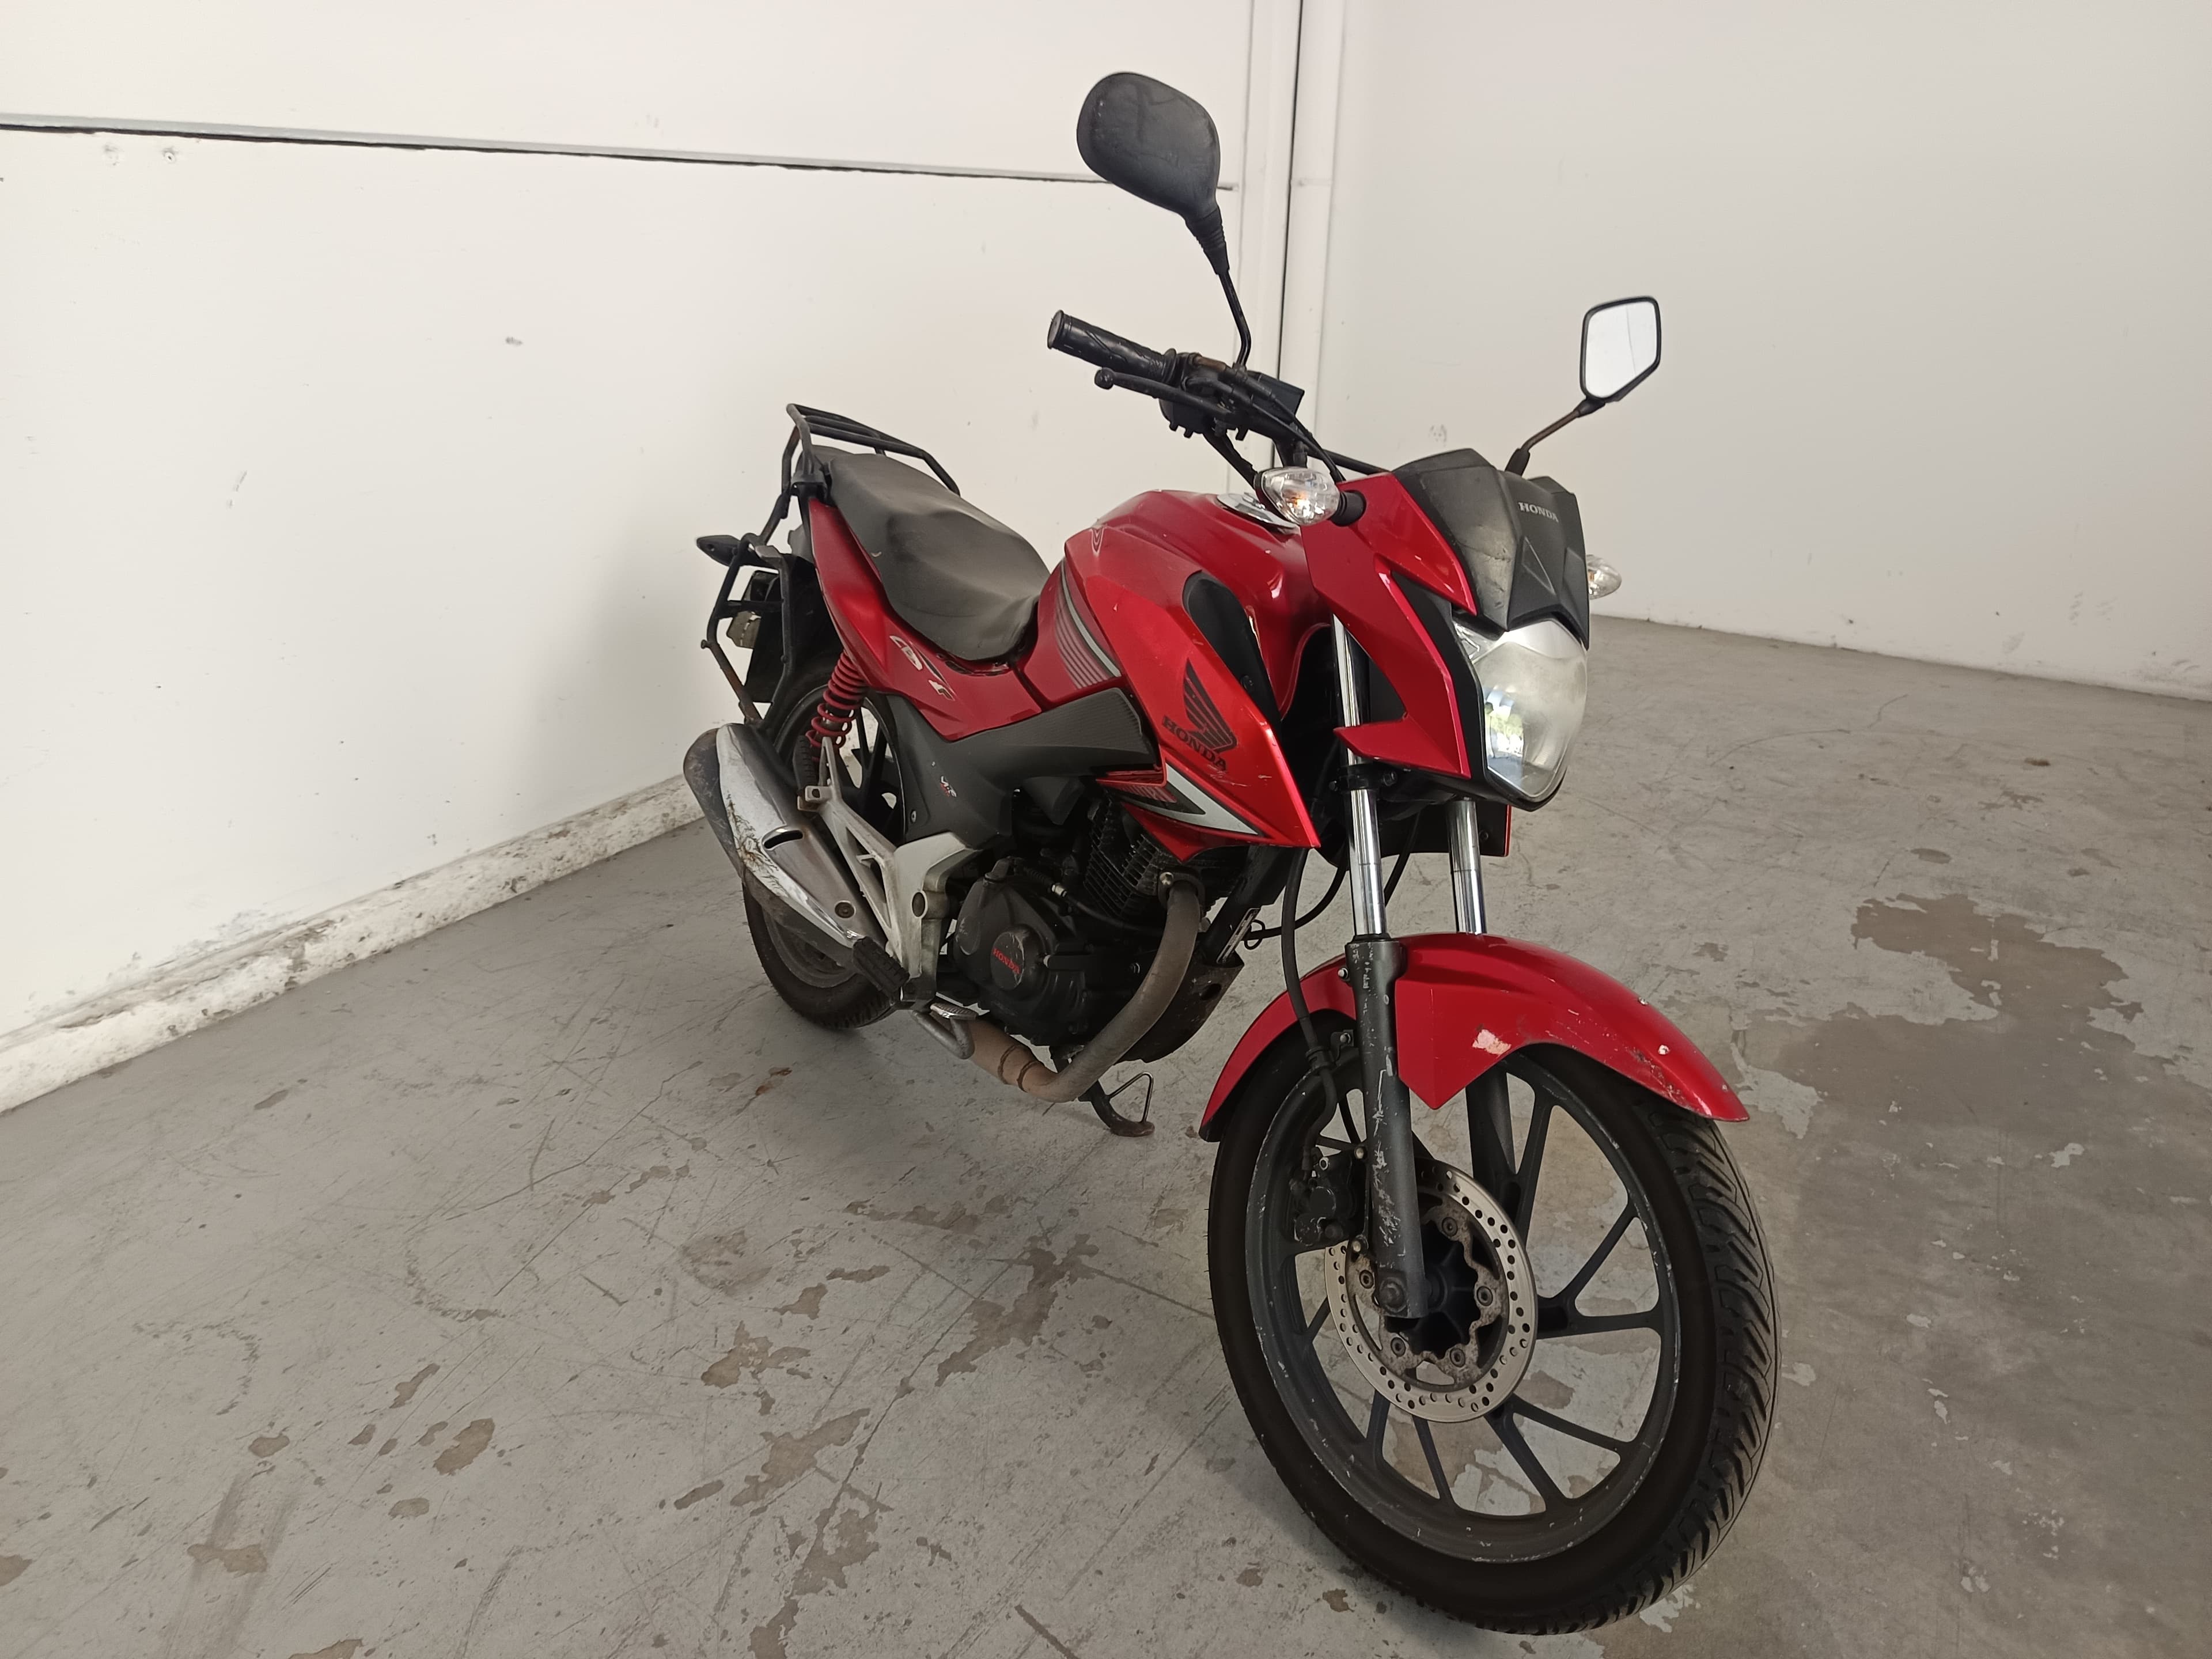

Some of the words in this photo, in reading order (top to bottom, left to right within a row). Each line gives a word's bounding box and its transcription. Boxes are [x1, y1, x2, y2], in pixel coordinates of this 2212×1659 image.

[1518, 502, 1559, 523] HONDA
[1162, 715, 1227, 771] HONDA
[993, 948, 1021, 975] HONDA
